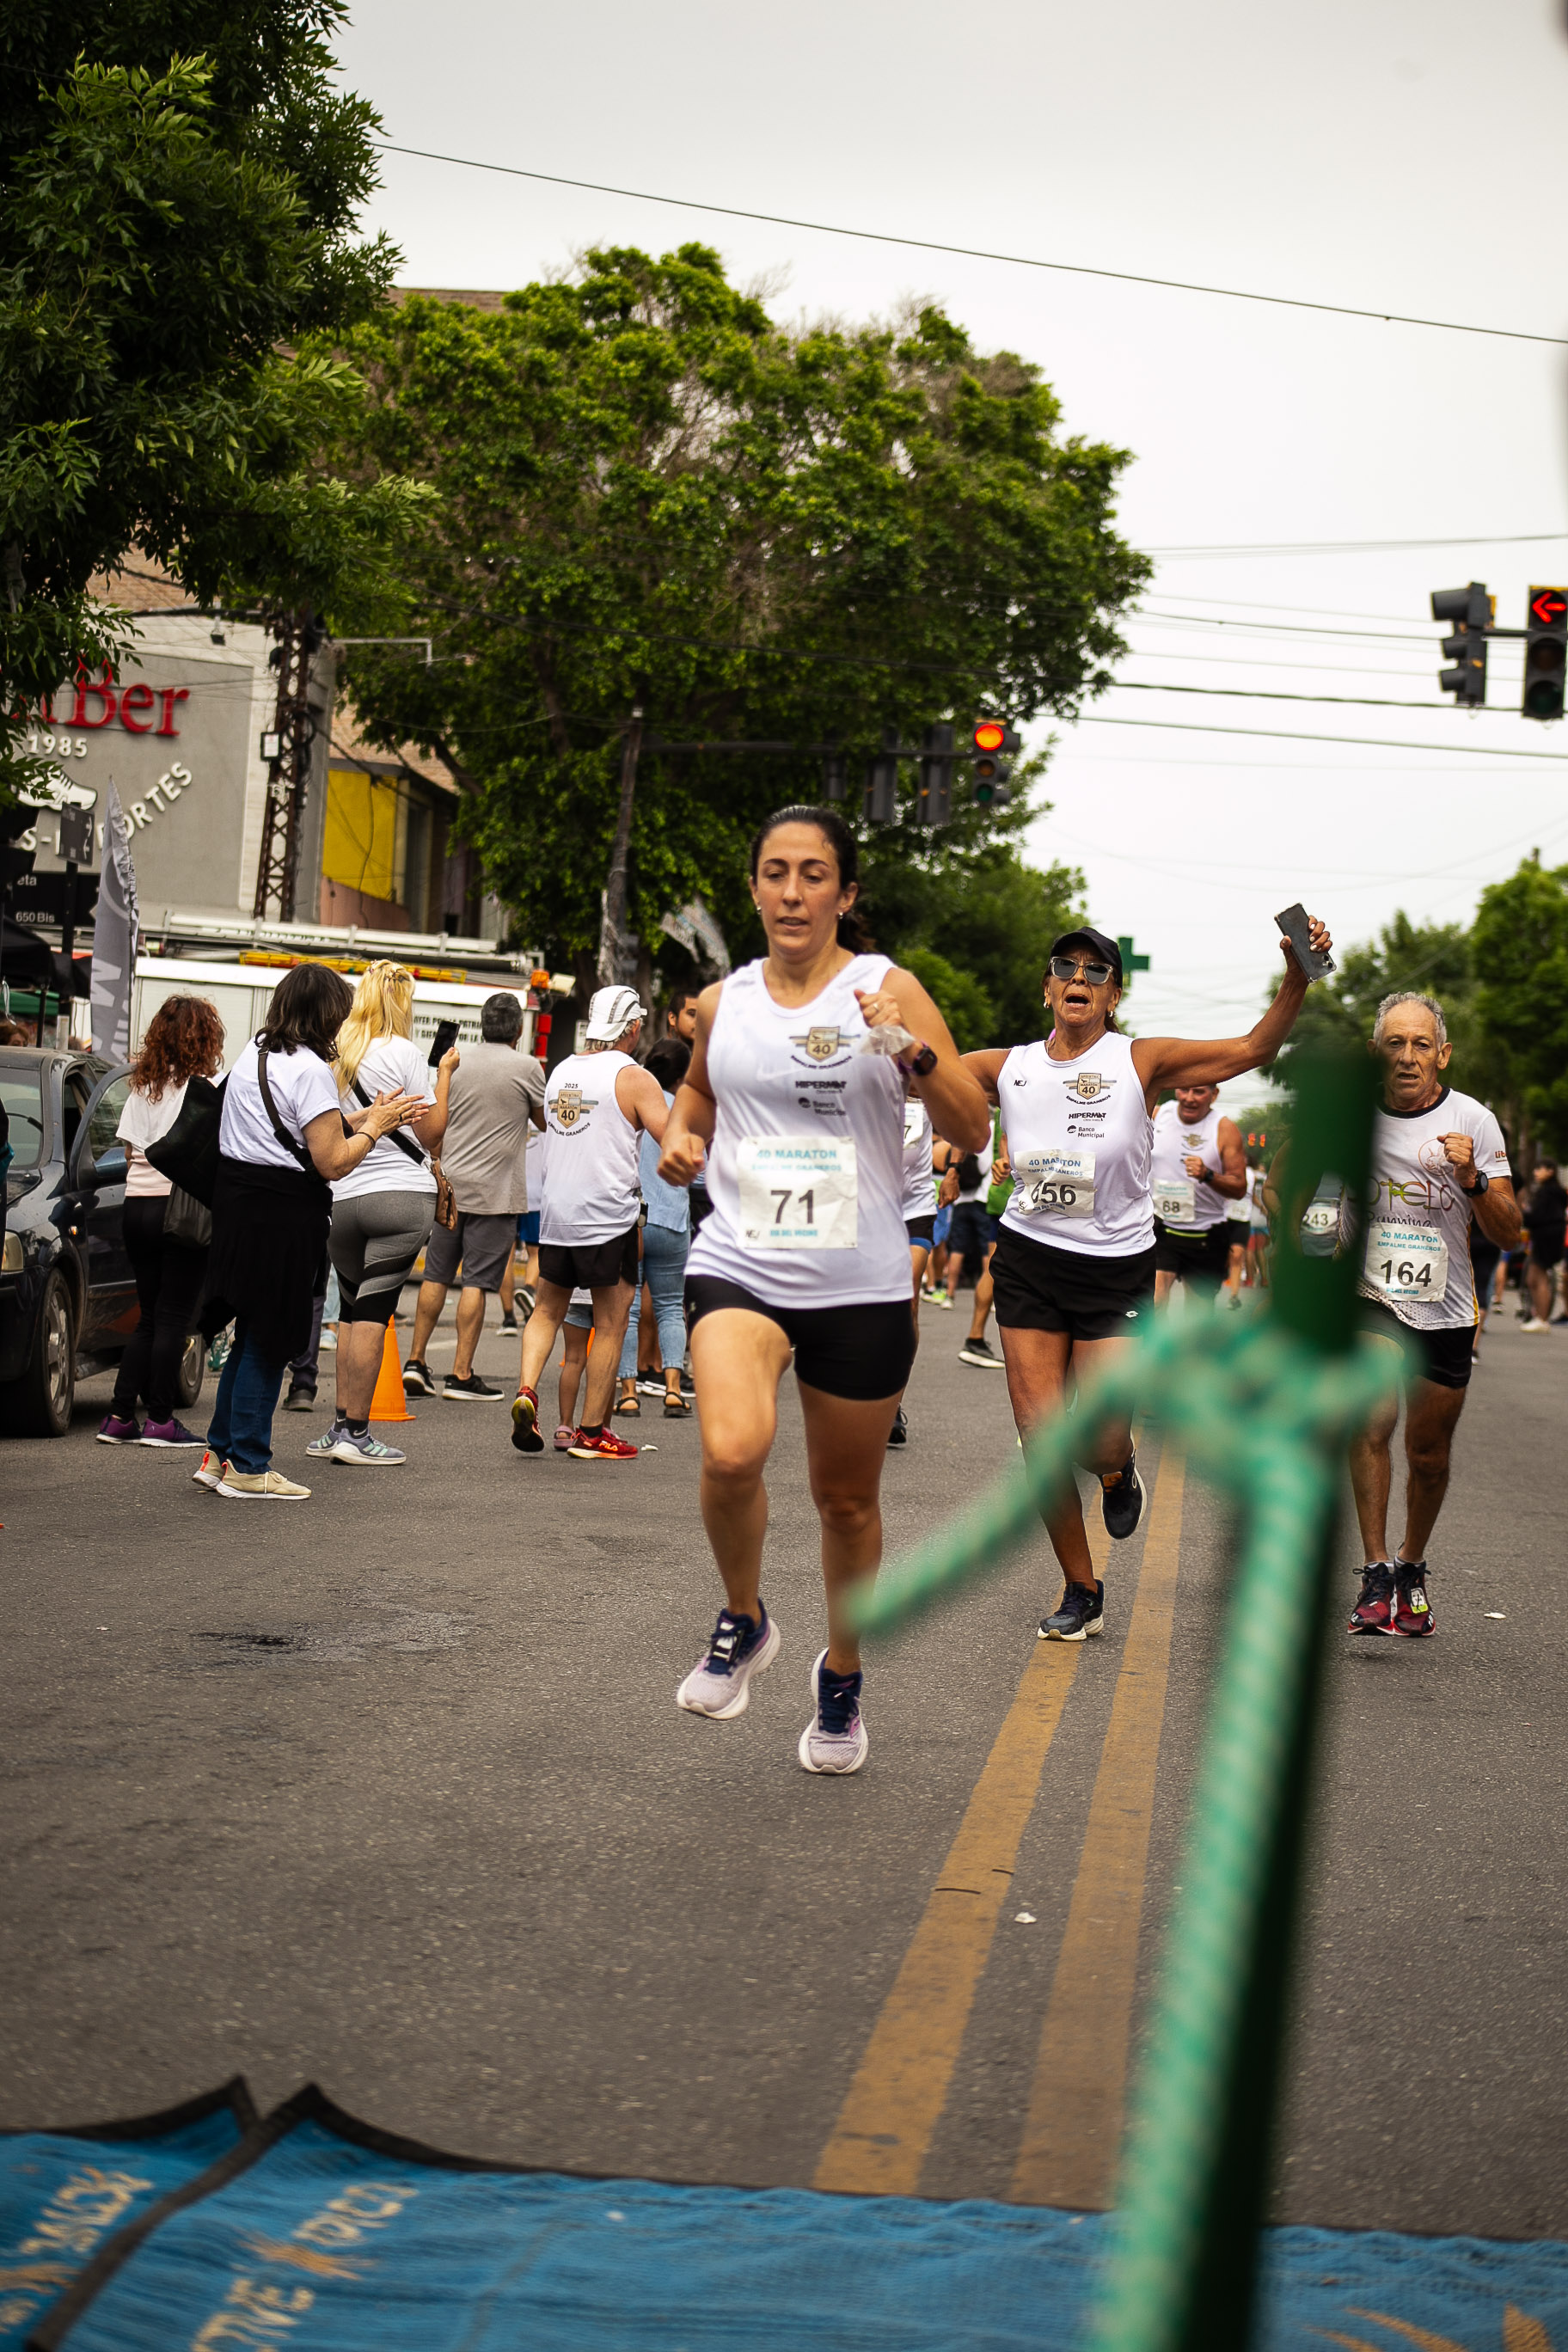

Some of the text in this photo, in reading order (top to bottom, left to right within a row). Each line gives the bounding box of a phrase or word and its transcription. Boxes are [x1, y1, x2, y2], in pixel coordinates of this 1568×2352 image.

[28, 733, 88, 758] 1985
[15, 911, 55, 923] 650 Bis
[812, 1044, 831, 1055] 40
[1081, 1086, 1095, 1094] 40
[560, 1109, 575, 1121] 40
[757, 1148, 837, 1159] 40 MARATON
[1042, 1156, 1081, 1167] MARTON
[1031, 1179, 1076, 1206] 656
[770, 1189, 814, 1224] 71
[1162, 1200, 1180, 1213] 68
[1302, 1213, 1328, 1227] 243
[1393, 1232, 1438, 1243] MARATON
[1377, 1240, 1406, 1249] EMPALME
[1380, 1259, 1432, 1288] 164
